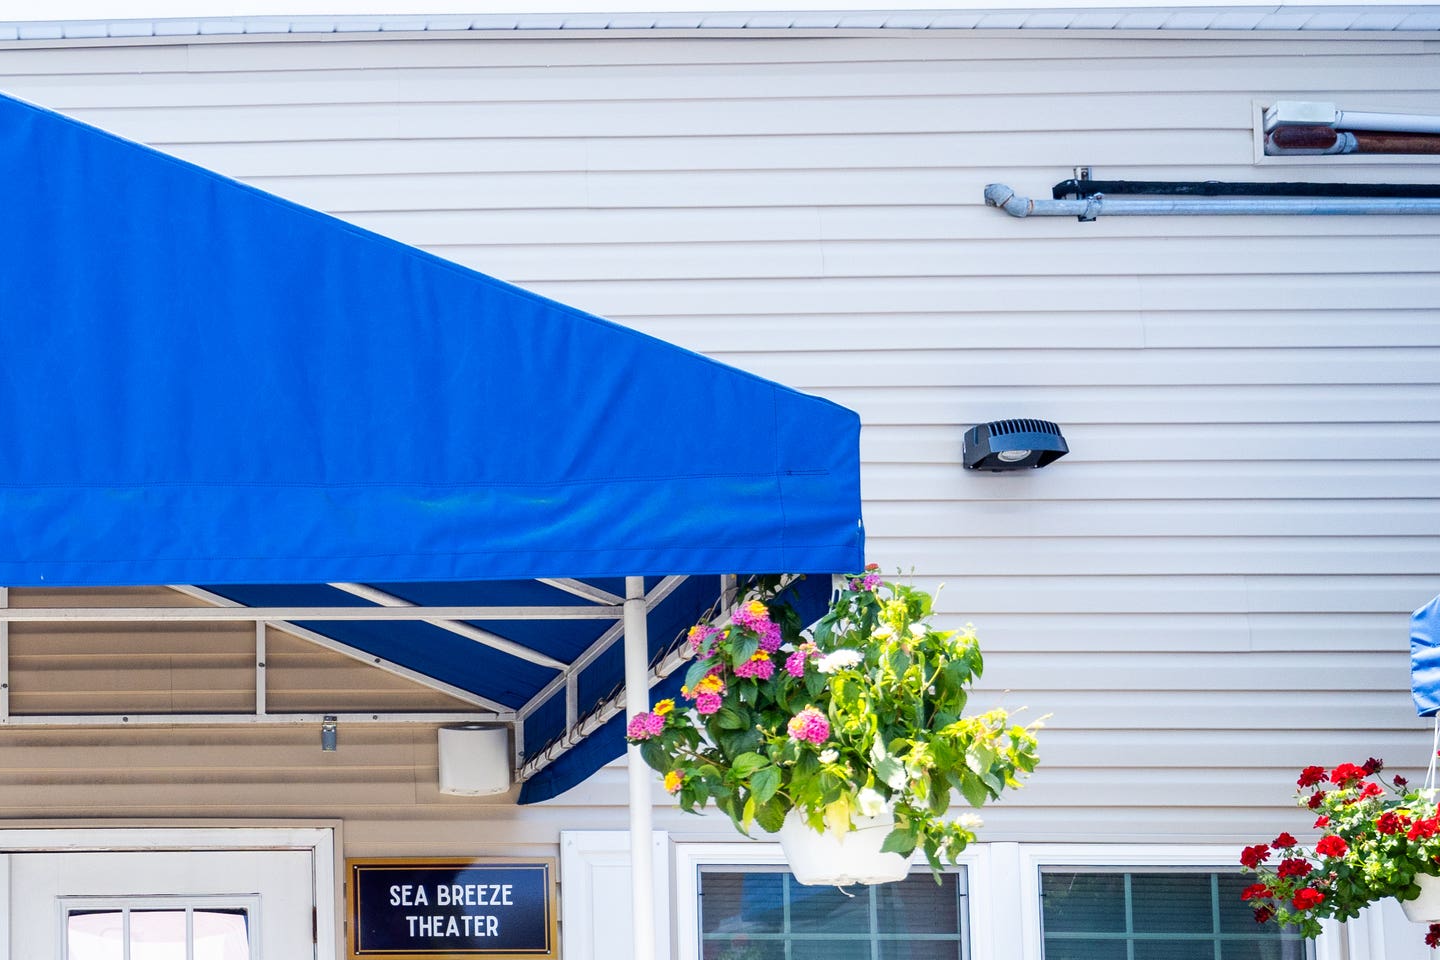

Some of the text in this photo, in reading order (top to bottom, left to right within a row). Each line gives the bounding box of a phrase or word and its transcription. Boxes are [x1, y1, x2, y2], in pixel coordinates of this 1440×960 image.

[389, 884, 514, 906] SEA BREEZE
[405, 915, 499, 937] THEATER
